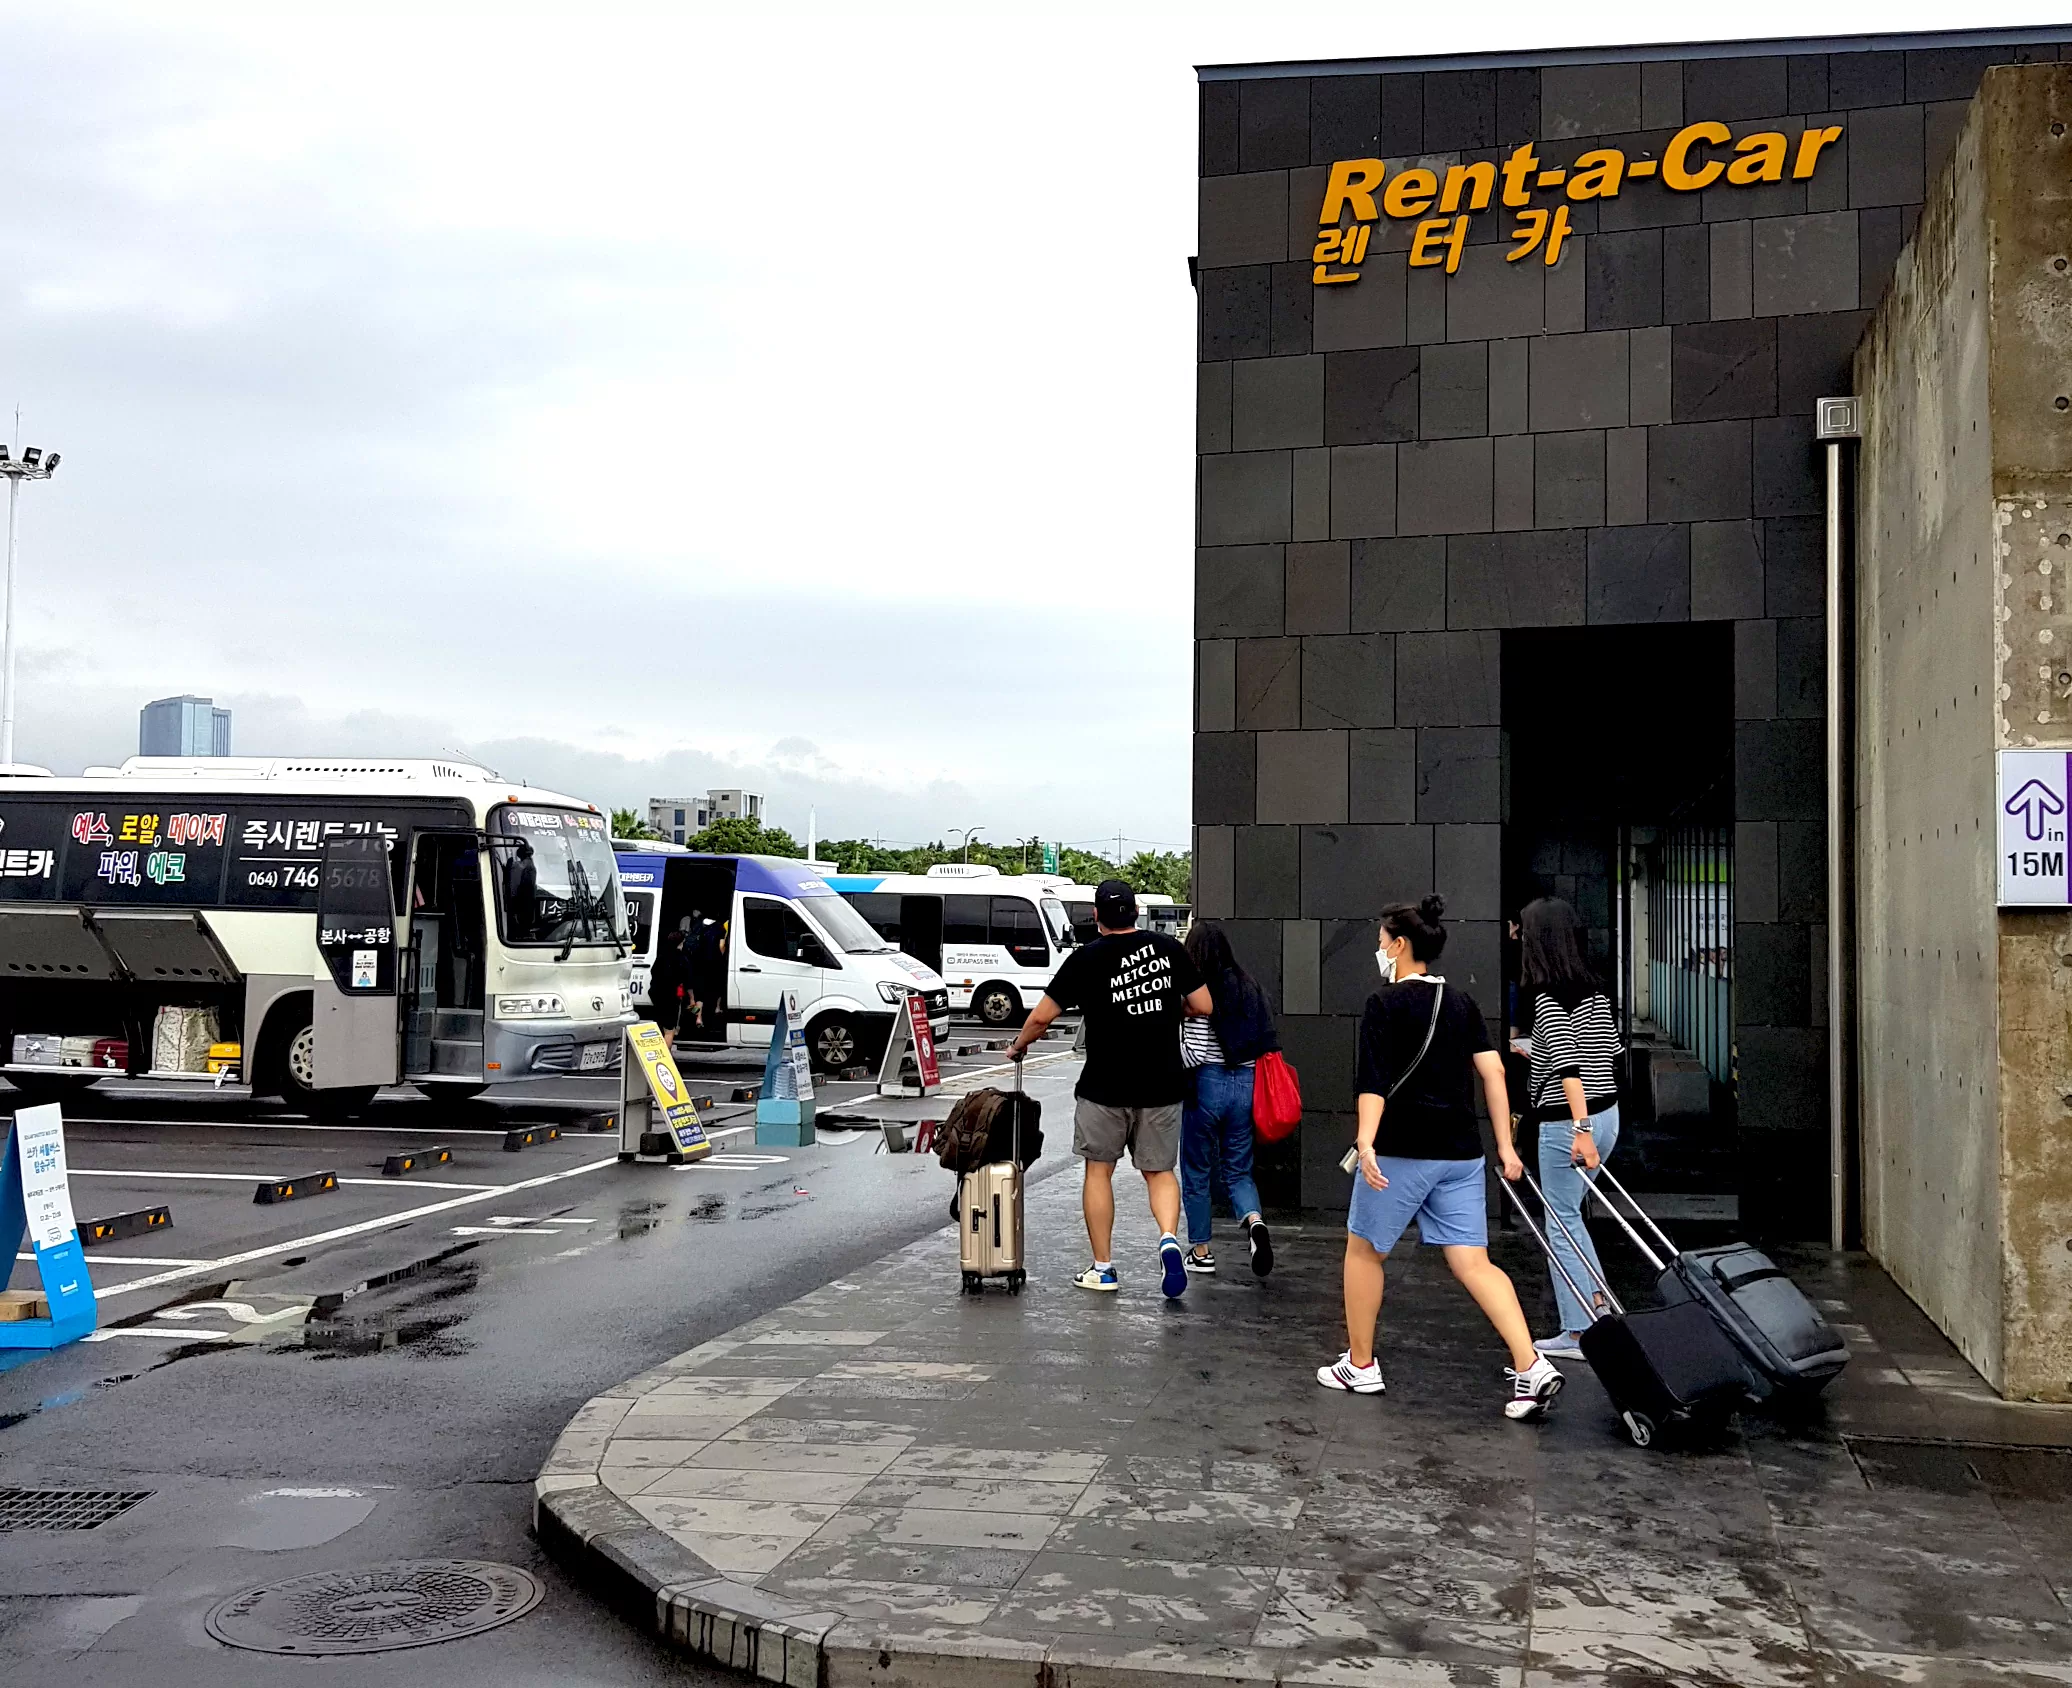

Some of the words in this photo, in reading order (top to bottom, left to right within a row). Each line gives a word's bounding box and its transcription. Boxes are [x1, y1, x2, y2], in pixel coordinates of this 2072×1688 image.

[1318, 121, 1844, 225] Rent-a-Car
[167, 813, 228, 845] 메이저
[2048, 828, 2064, 842] in
[147, 853, 186, 884] 에코
[2007, 851, 2064, 877] 15M
[248, 871, 279, 887] 064)
[320, 928, 347, 945] 본사
[363, 927, 391, 944] 공항
[1120, 944, 1156, 968] ANTI
[1110, 956, 1171, 988] METCON
[1112, 975, 1172, 1003] METCON
[1127, 998, 1163, 1015] CLUB
